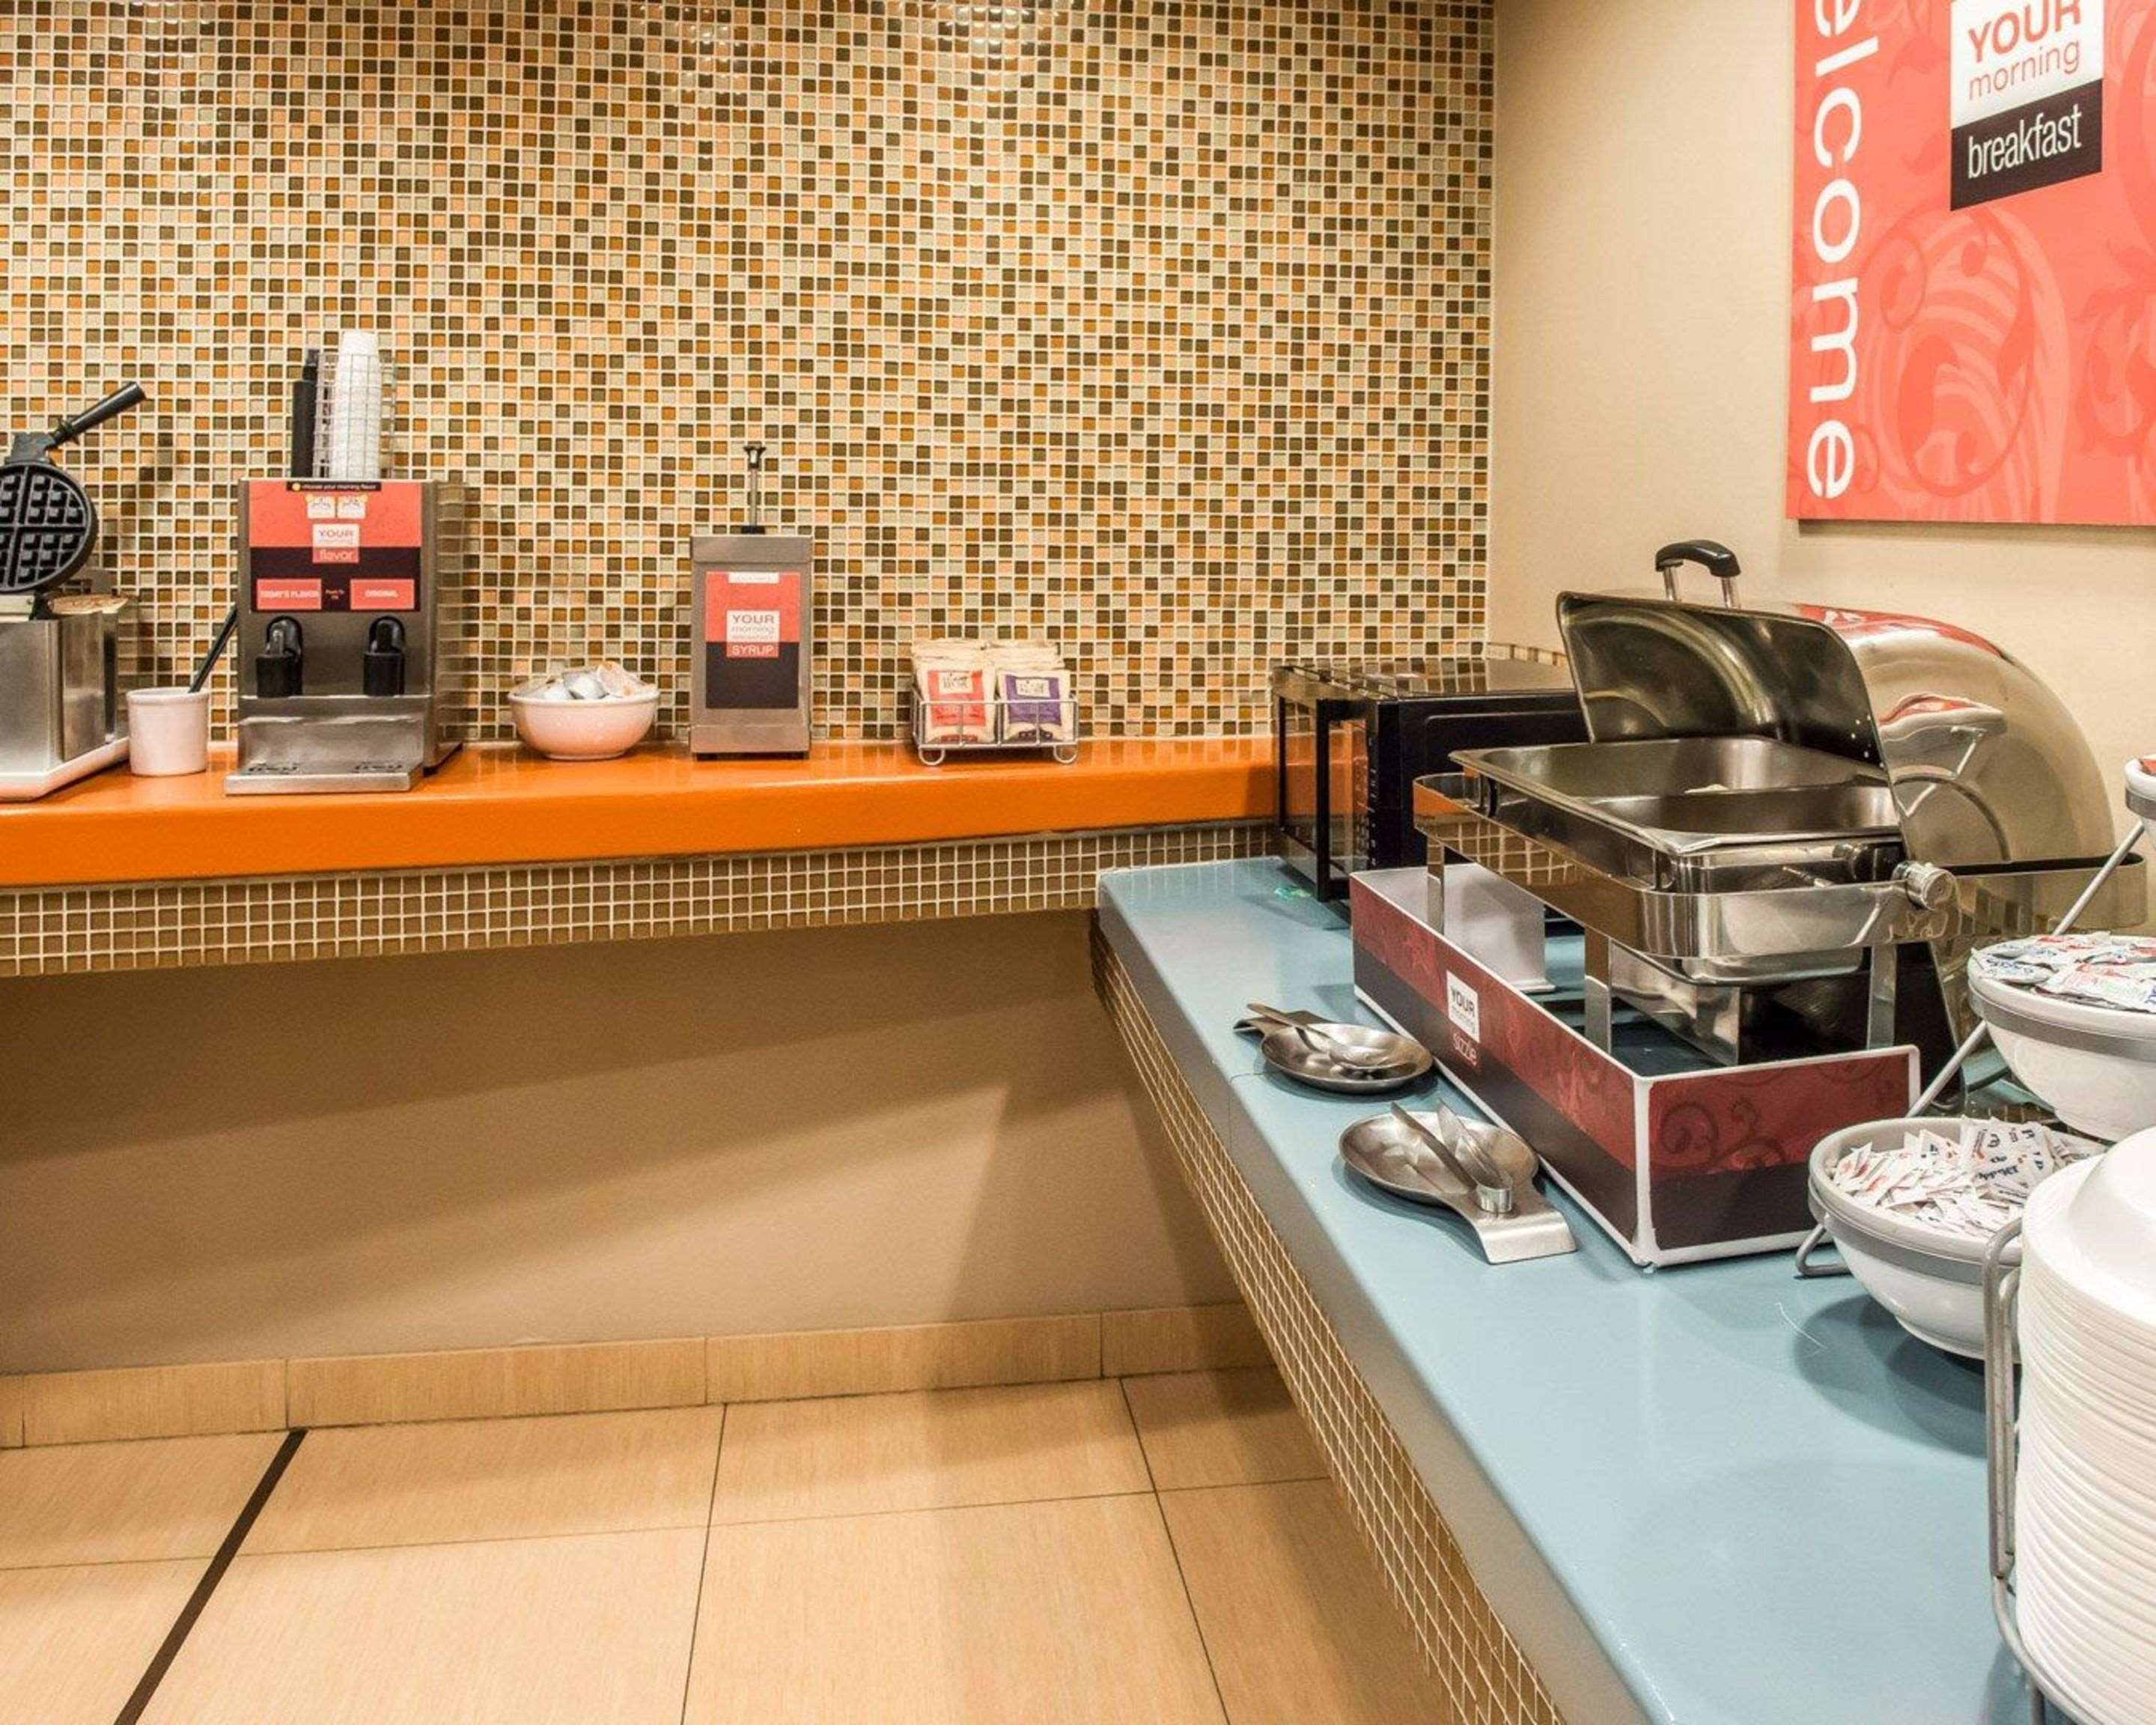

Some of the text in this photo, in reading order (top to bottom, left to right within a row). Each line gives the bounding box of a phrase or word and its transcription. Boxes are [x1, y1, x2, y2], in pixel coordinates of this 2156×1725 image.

[1968, 0, 2081, 63] YOUR
[1969, 40, 2080, 100] morning
[1968, 103, 2083, 180] breakfast
[318, 529, 354, 538] YOUR
[732, 614, 775, 624] YOUR
[731, 645, 774, 656] SYRUP
